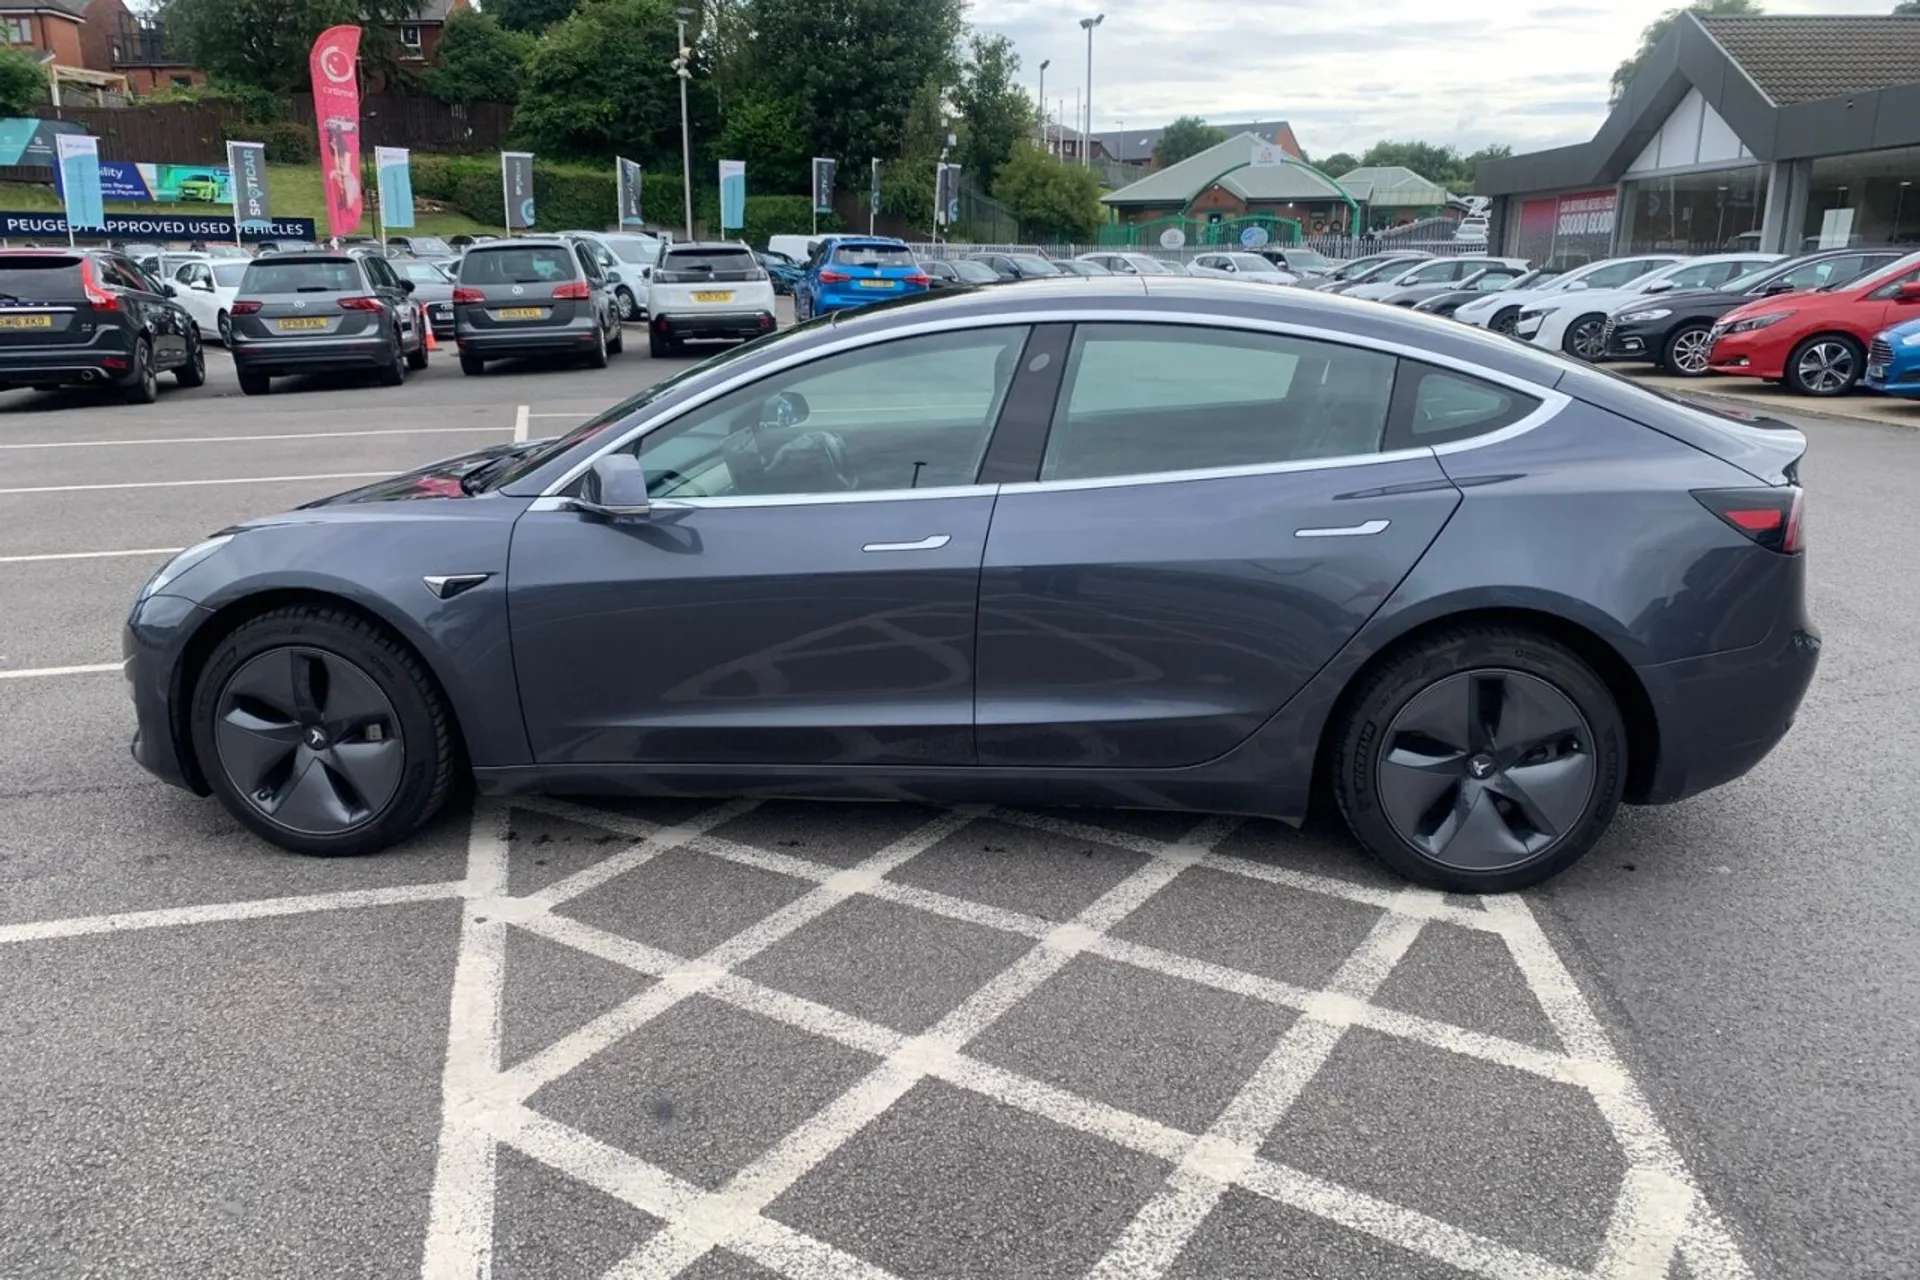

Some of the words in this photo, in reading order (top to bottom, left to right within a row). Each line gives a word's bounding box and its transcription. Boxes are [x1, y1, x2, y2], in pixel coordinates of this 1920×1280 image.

[243, 149, 265, 216] SPOTICAR
[95, 220, 185, 233] APPROVED
[189, 221, 230, 234] USED
[234, 223, 305, 235] VEHICLES
